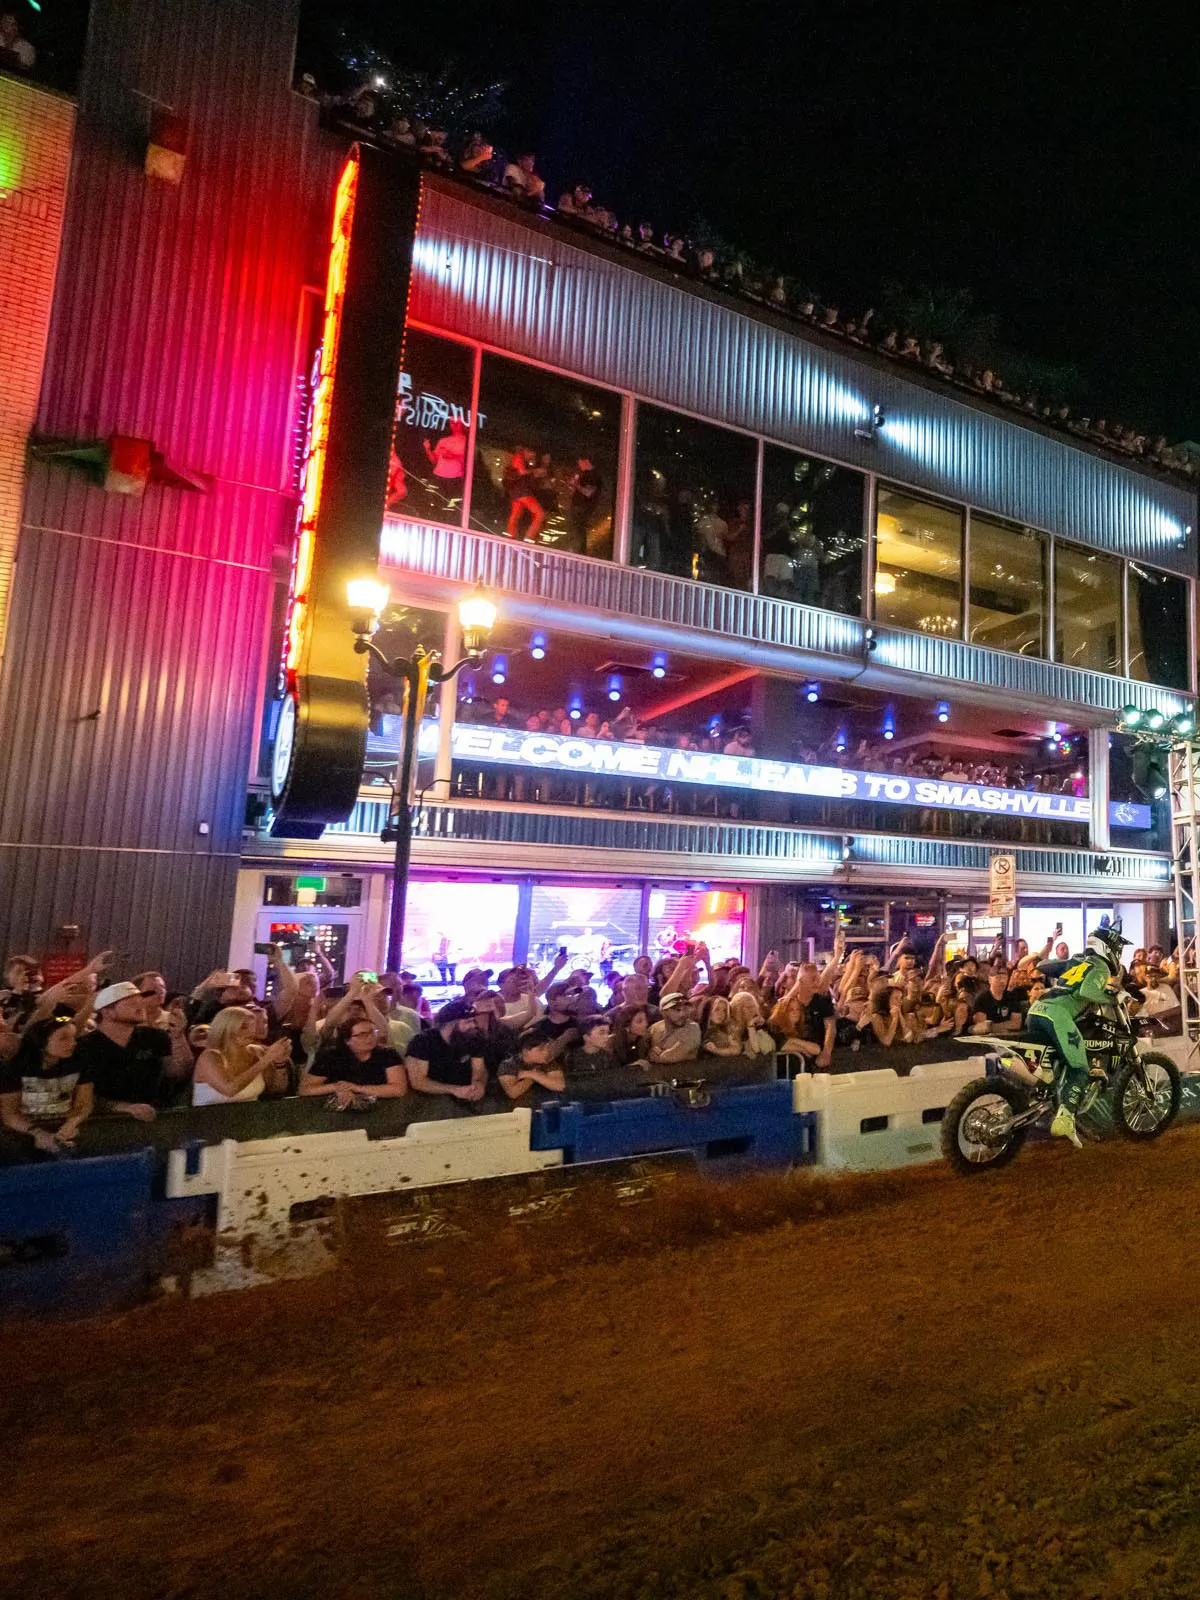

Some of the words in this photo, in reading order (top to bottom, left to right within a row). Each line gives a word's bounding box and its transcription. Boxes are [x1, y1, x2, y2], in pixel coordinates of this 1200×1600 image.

[417, 723, 660, 775] WELCOME
[864, 776, 910, 800] TO
[915, 782, 1091, 817] SMASHVILLE
[1060, 962, 1092, 986] 4
[1085, 1040, 1114, 1049] IUMPH
[1024, 1049, 1038, 1063] 4
